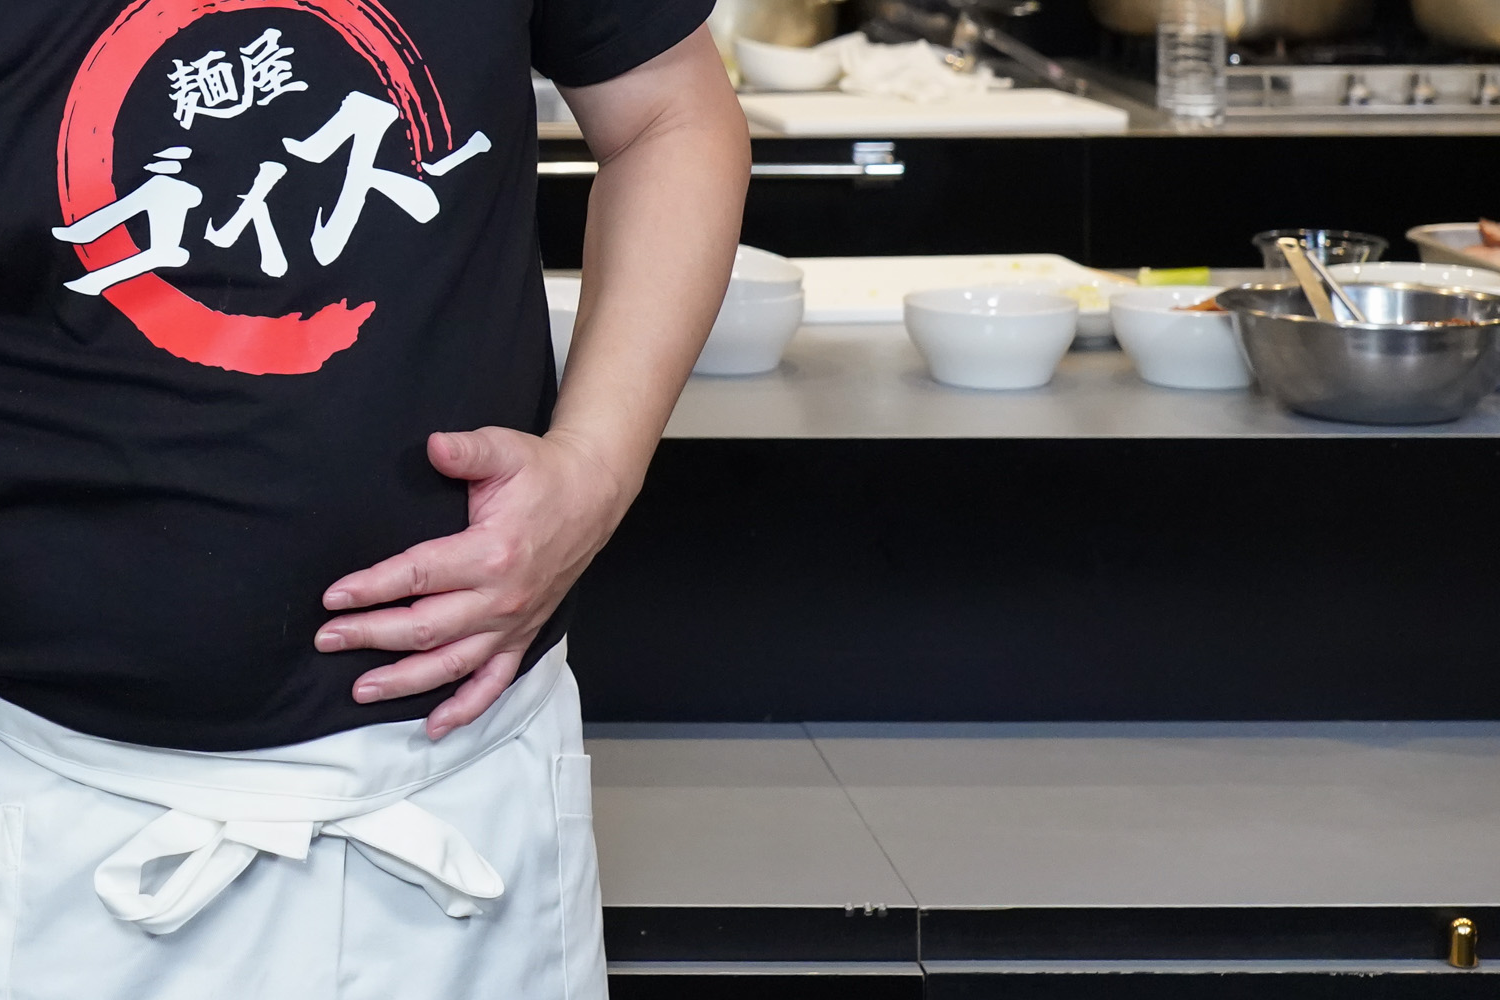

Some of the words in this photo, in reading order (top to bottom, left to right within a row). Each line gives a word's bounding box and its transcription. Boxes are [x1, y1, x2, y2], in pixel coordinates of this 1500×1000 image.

[166, 27, 309, 130] 麺屋
[51, 90, 492, 296] ゴイスー
